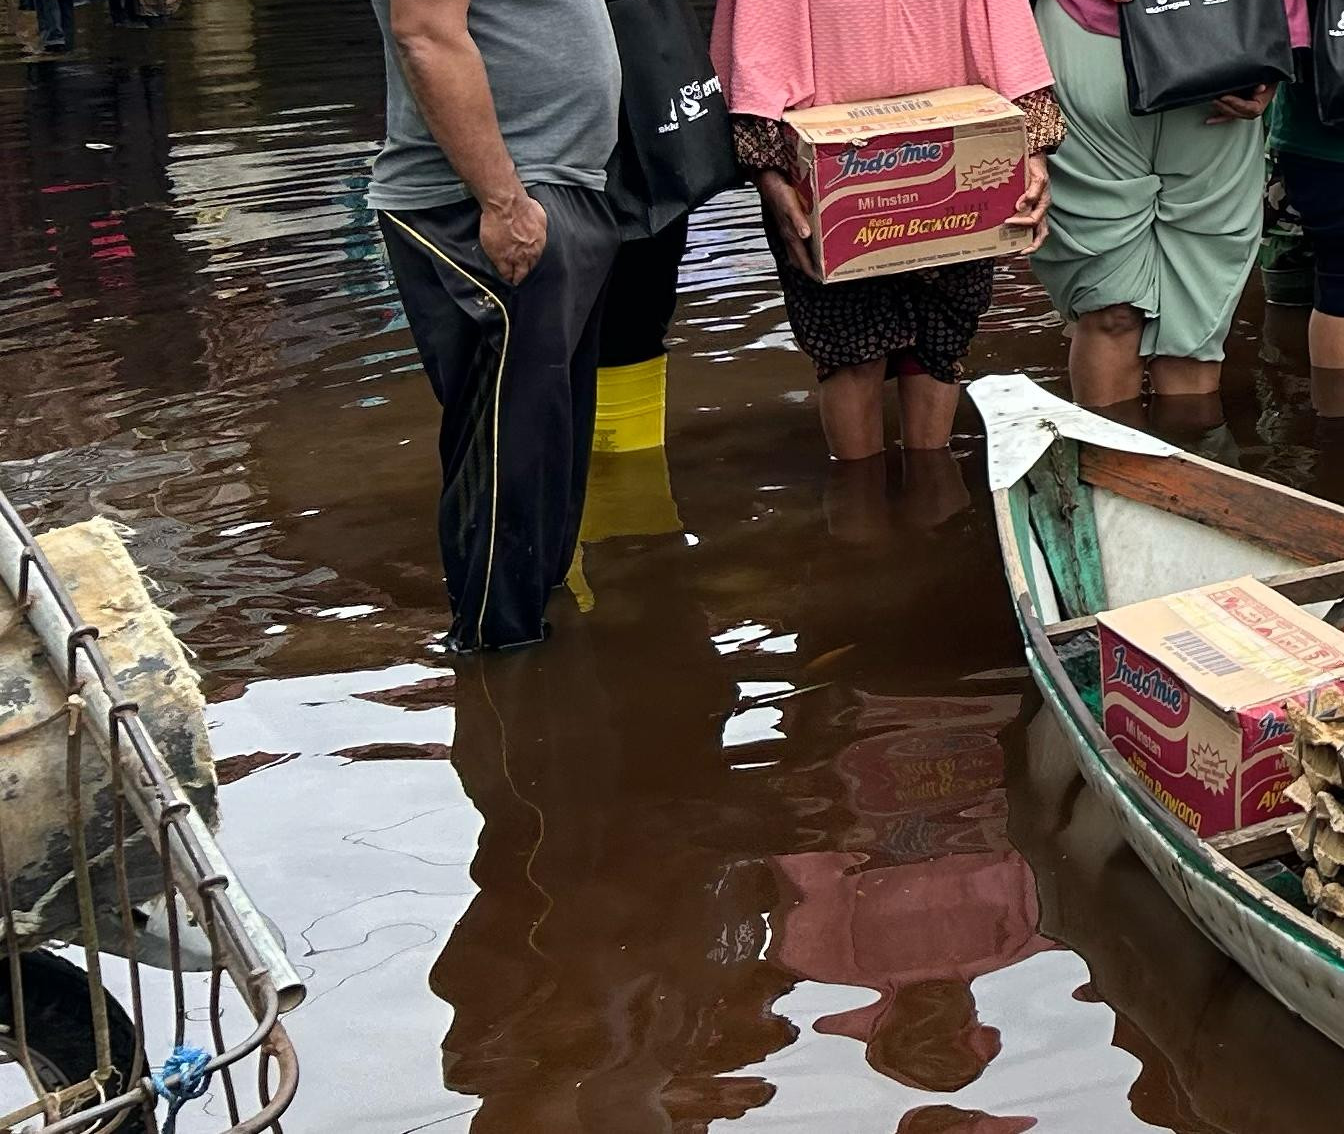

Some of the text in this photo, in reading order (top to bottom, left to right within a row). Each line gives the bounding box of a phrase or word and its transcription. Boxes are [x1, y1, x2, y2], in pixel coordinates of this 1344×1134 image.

[830, 141, 942, 184] Indomie
[858, 191, 920, 211] Mi Instan
[853, 212, 980, 247] Ayam Bawang
[1108, 643, 1183, 715] Indomie
[1135, 726, 1162, 759] Instan
